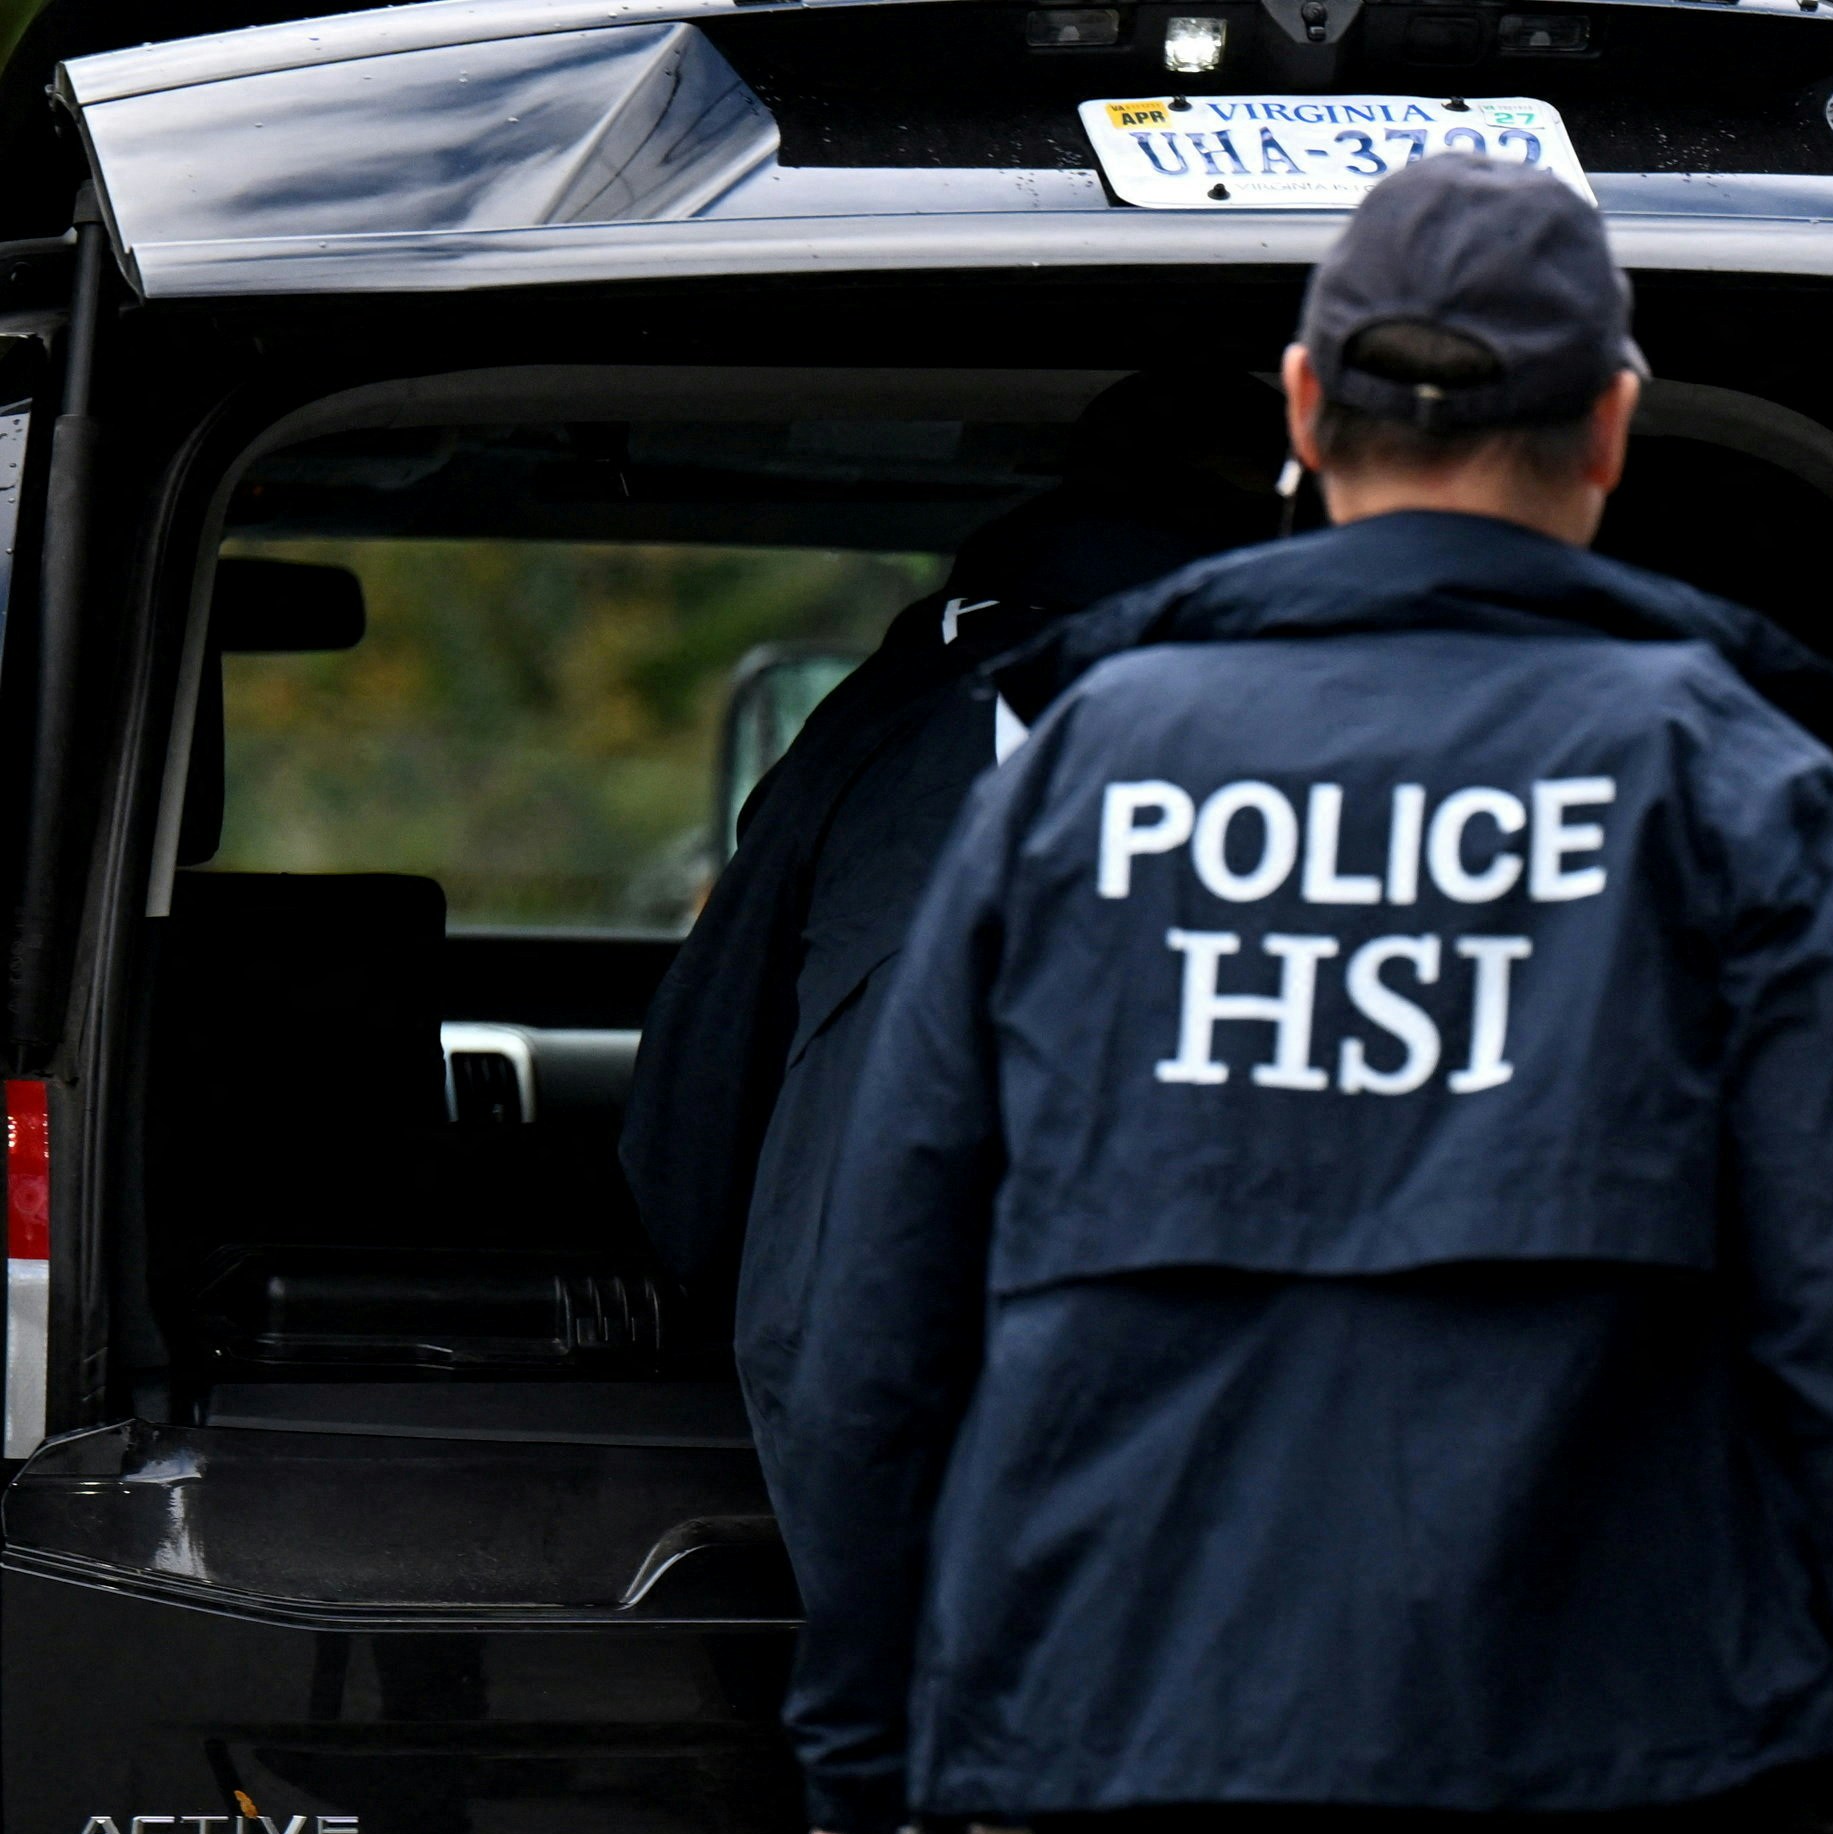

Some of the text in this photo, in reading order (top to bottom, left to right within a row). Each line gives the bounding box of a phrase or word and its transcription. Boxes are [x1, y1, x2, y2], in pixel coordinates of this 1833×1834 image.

[1122, 110, 1166, 125] APR
[1207, 102, 1438, 125] VIRGINIA
[1494, 112, 1535, 125] 27
[1097, 775, 1616, 906] POLICE
[1154, 927, 1534, 1095] HSI
